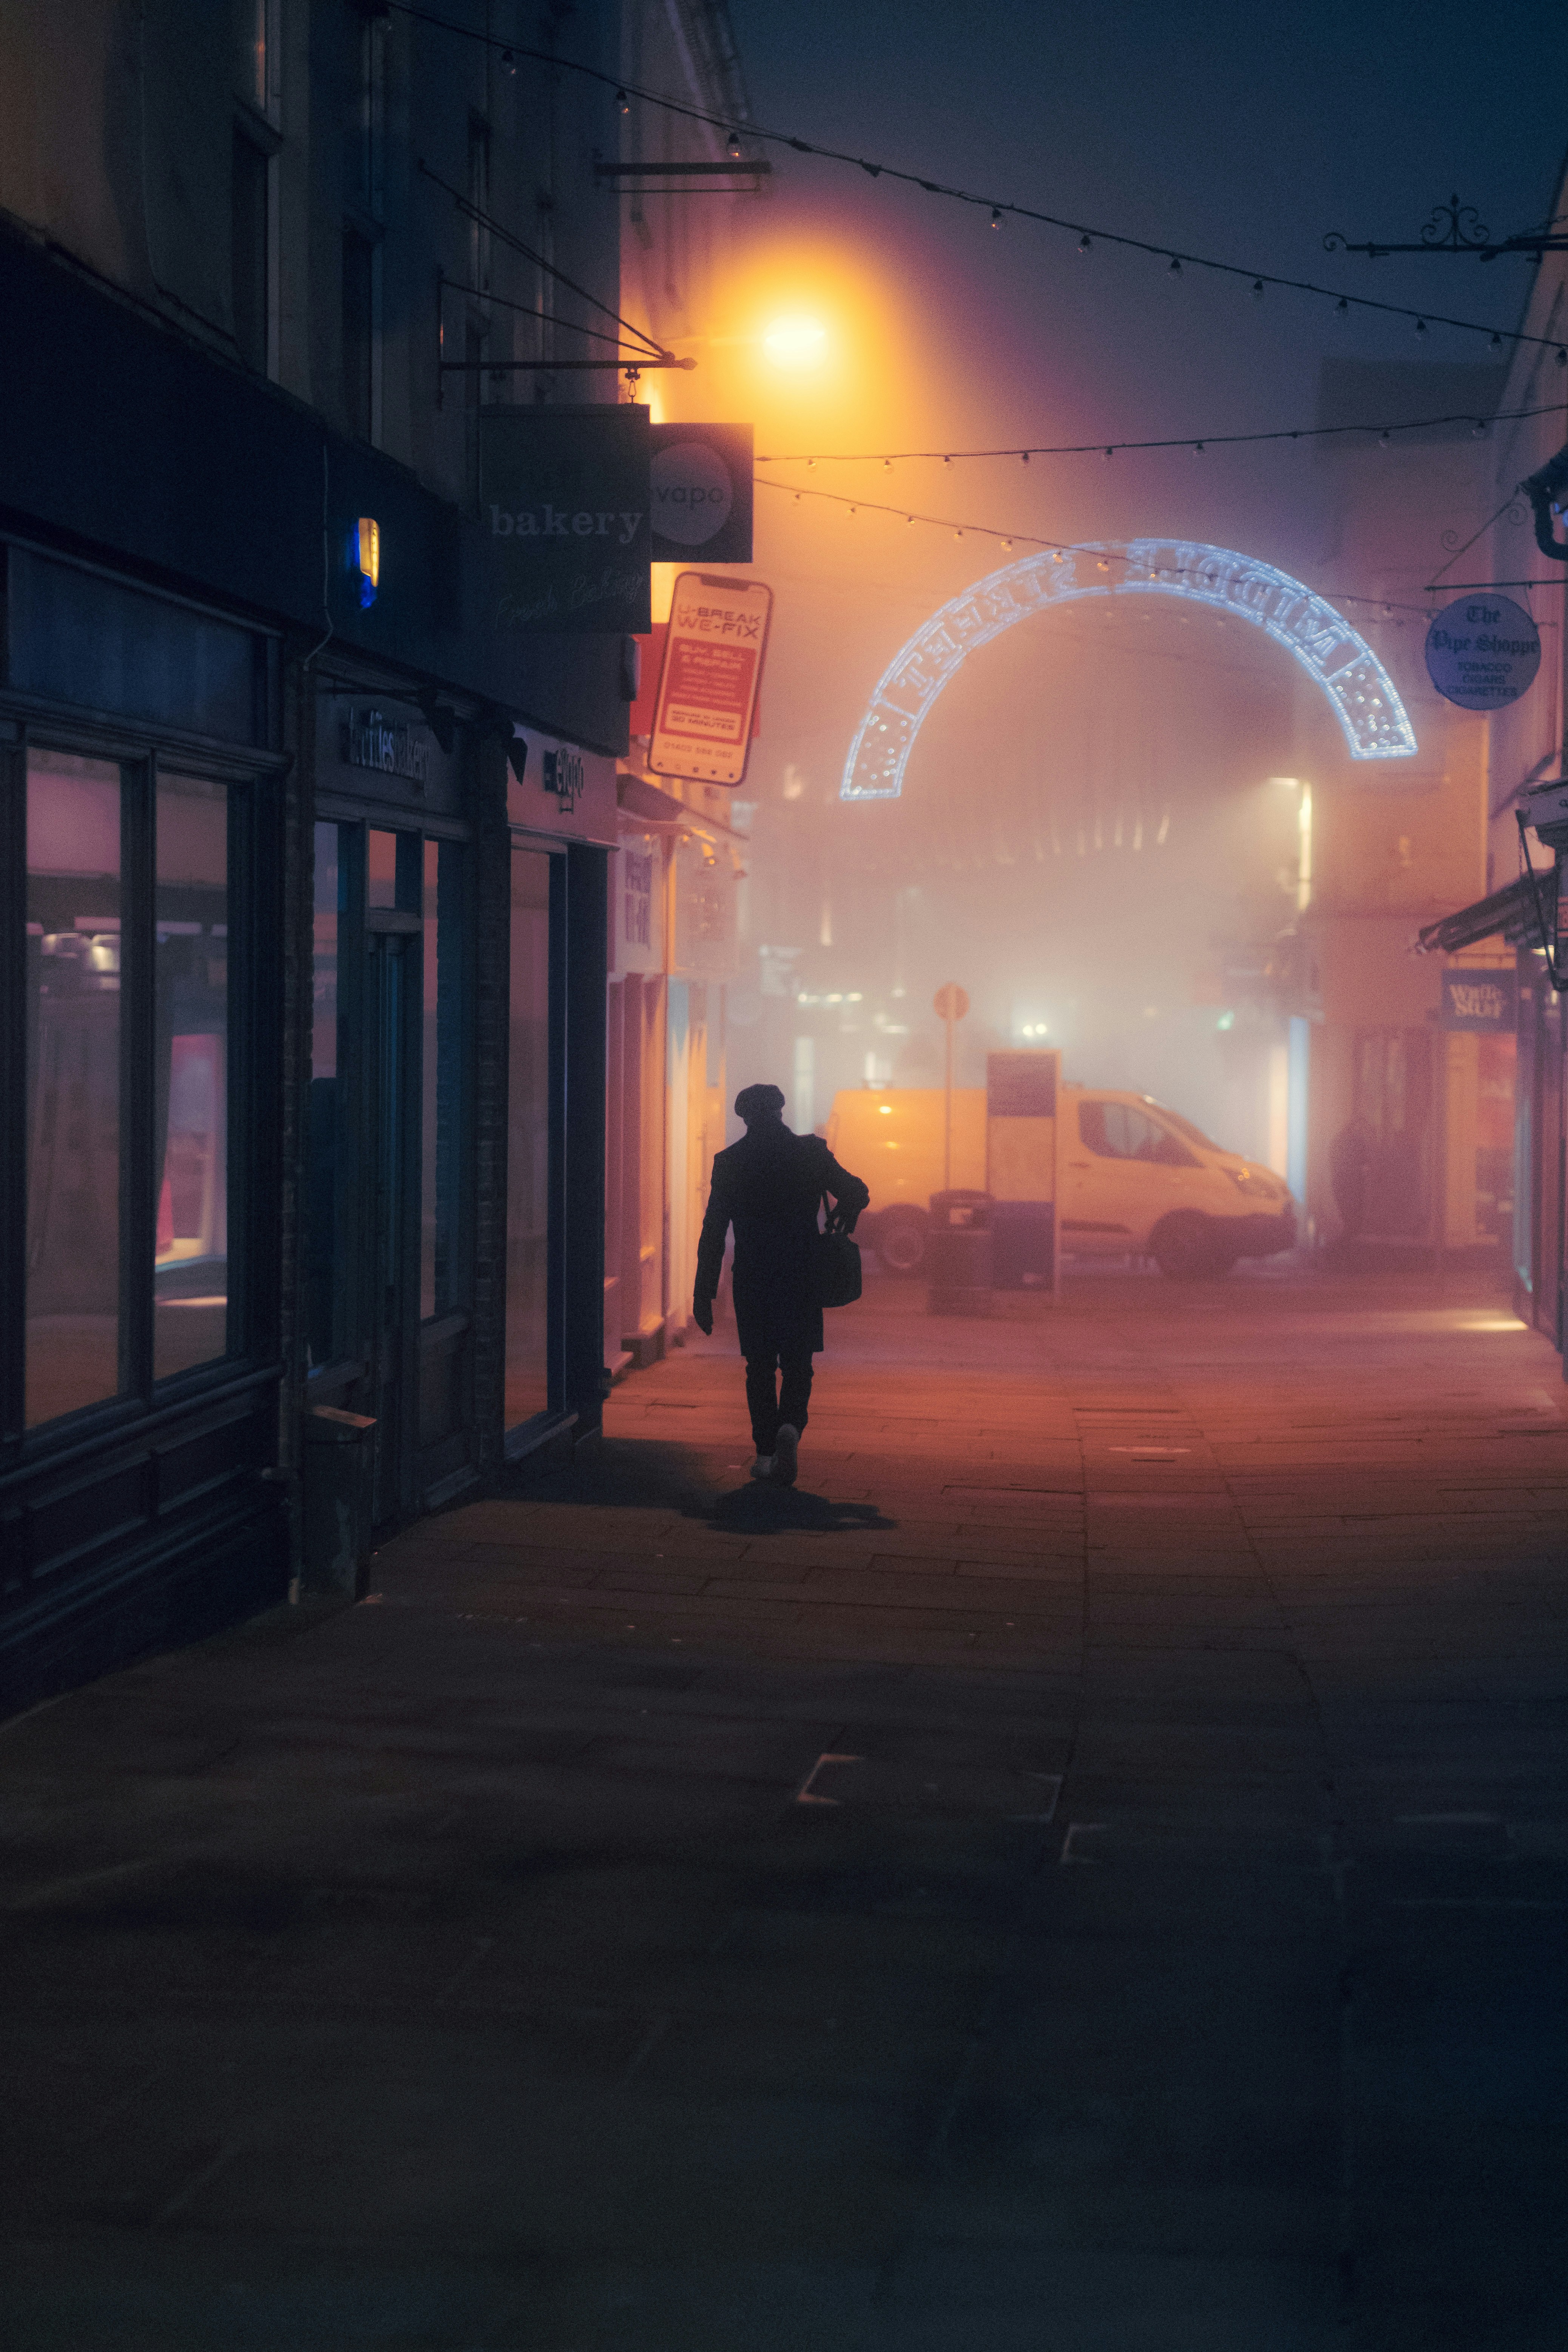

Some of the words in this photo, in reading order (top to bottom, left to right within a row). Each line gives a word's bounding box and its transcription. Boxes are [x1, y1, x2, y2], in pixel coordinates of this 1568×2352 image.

[650, 486, 724, 510] vapo
[489, 504, 643, 544] bakery
[678, 605, 761, 625] U-BREAK
[1466, 605, 1501, 625] The
[677, 616, 759, 639] WE-FIX
[1432, 630, 1471, 654] Pipe
[1476, 634, 1540, 656] Shoppe
[1457, 662, 1512, 673] TOBACCO
[1447, 685, 1517, 697] CIGARETTES
[687, 718, 736, 732] MINUTES
